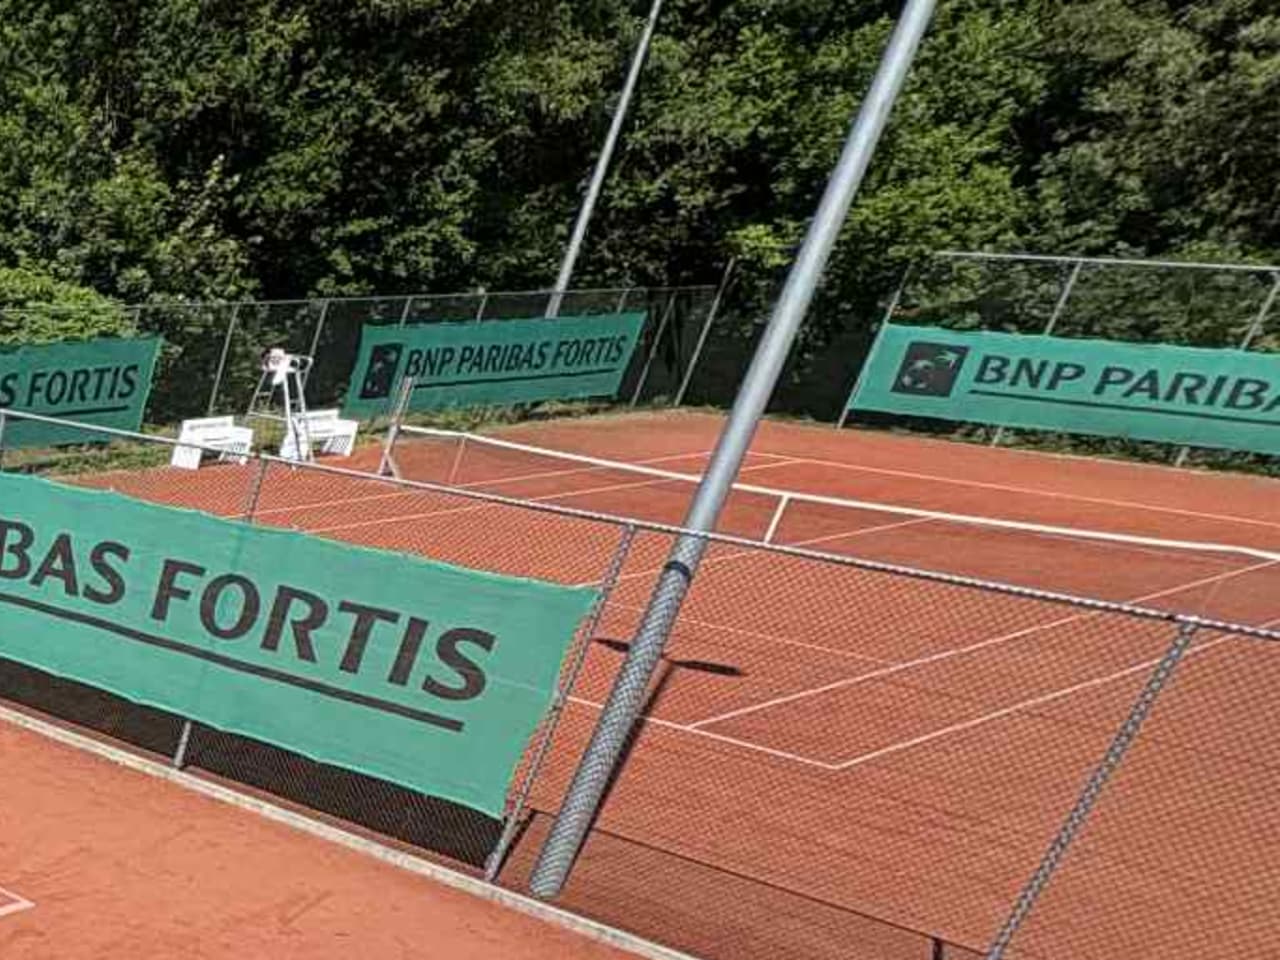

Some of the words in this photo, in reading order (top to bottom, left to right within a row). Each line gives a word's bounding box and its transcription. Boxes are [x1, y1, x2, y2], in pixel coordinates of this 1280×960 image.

[405, 346, 455, 377] BNP
[456, 342, 548, 374] PARIBAS
[551, 335, 628, 368] FORTIS
[972, 353, 1086, 391] BNP
[25, 364, 139, 407] FORTIS
[150, 558, 497, 702] FORTIS
